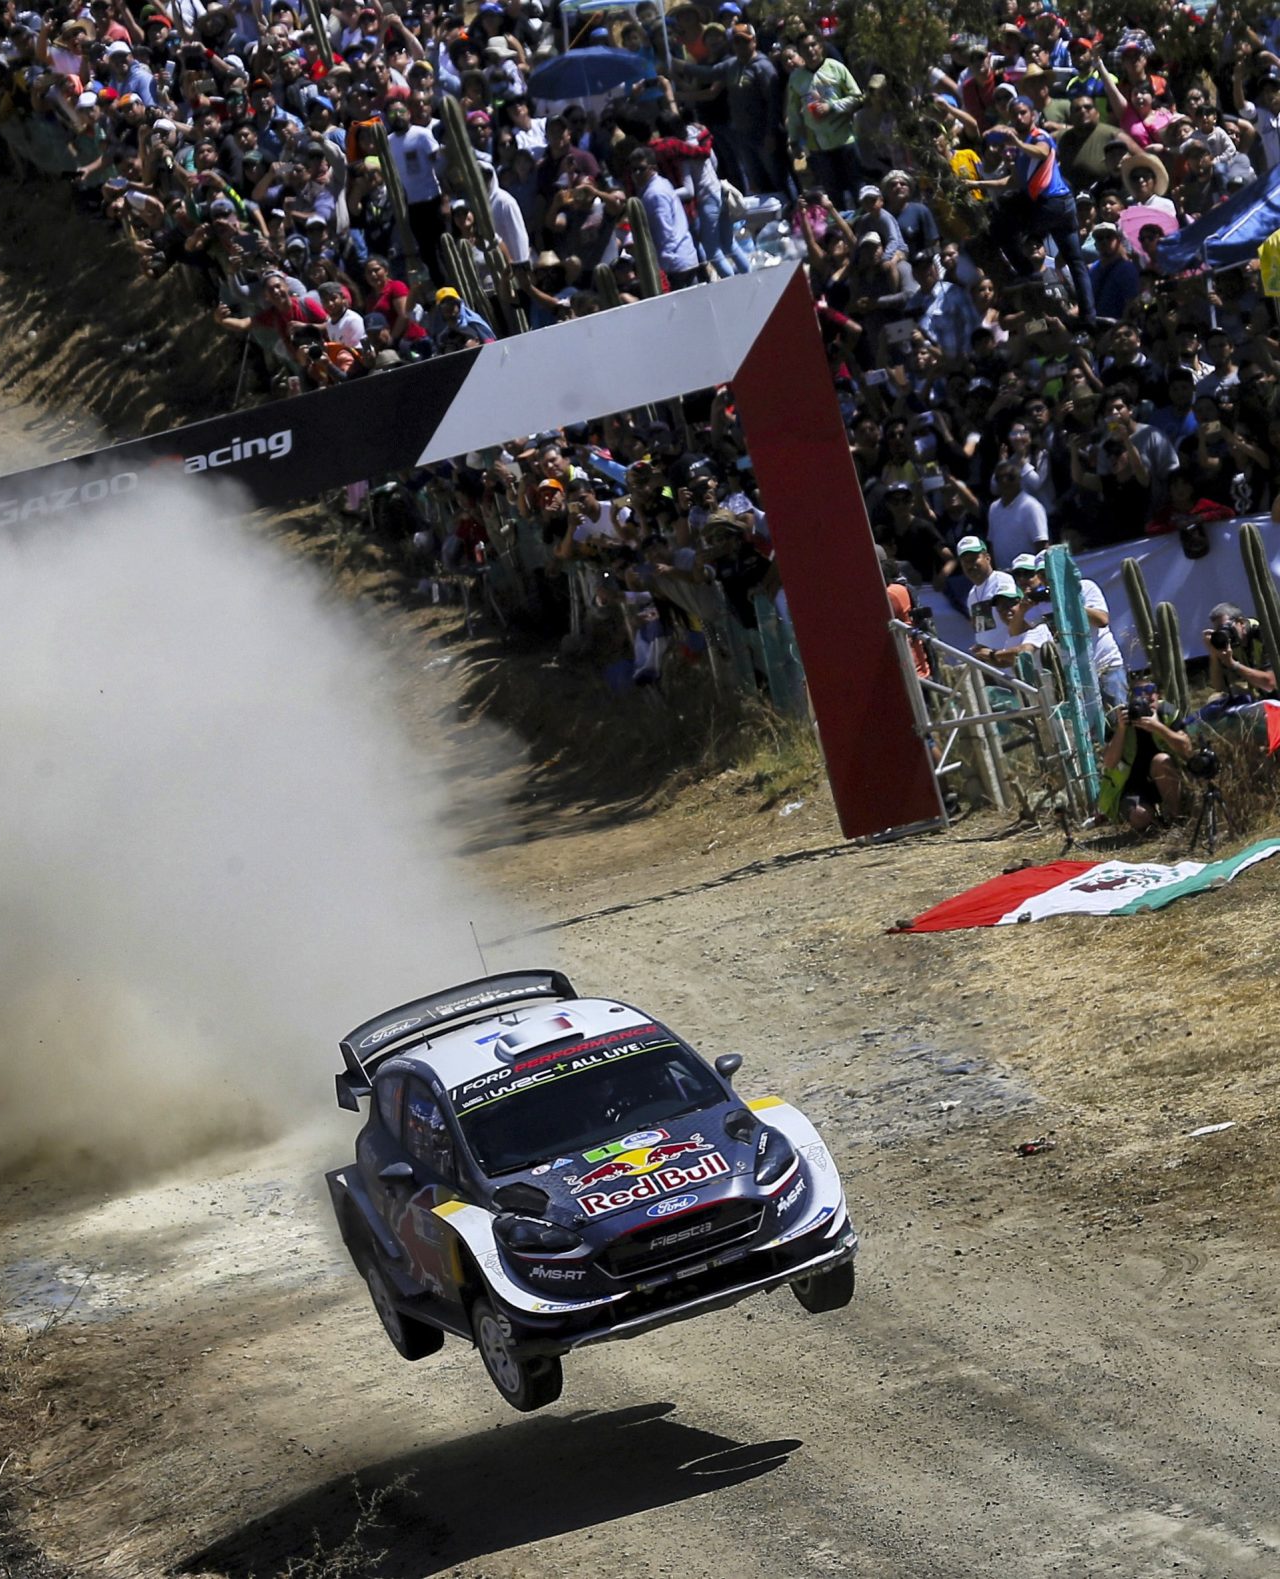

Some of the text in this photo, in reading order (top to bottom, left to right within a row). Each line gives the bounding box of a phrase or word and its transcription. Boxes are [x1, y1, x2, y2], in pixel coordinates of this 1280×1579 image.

[151, 429, 293, 479] acing
[441, 984, 548, 1015] EcoBoost
[371, 1022, 414, 1043] Ford
[462, 1025, 658, 1094] FORD PERFORMANCE
[571, 1055, 603, 1070] ALL
[603, 1042, 640, 1059] LIVE
[577, 1152, 731, 1217] Red Bull
[657, 1198, 689, 1215] Ford
[538, 1268, 586, 1281] MS-RT
